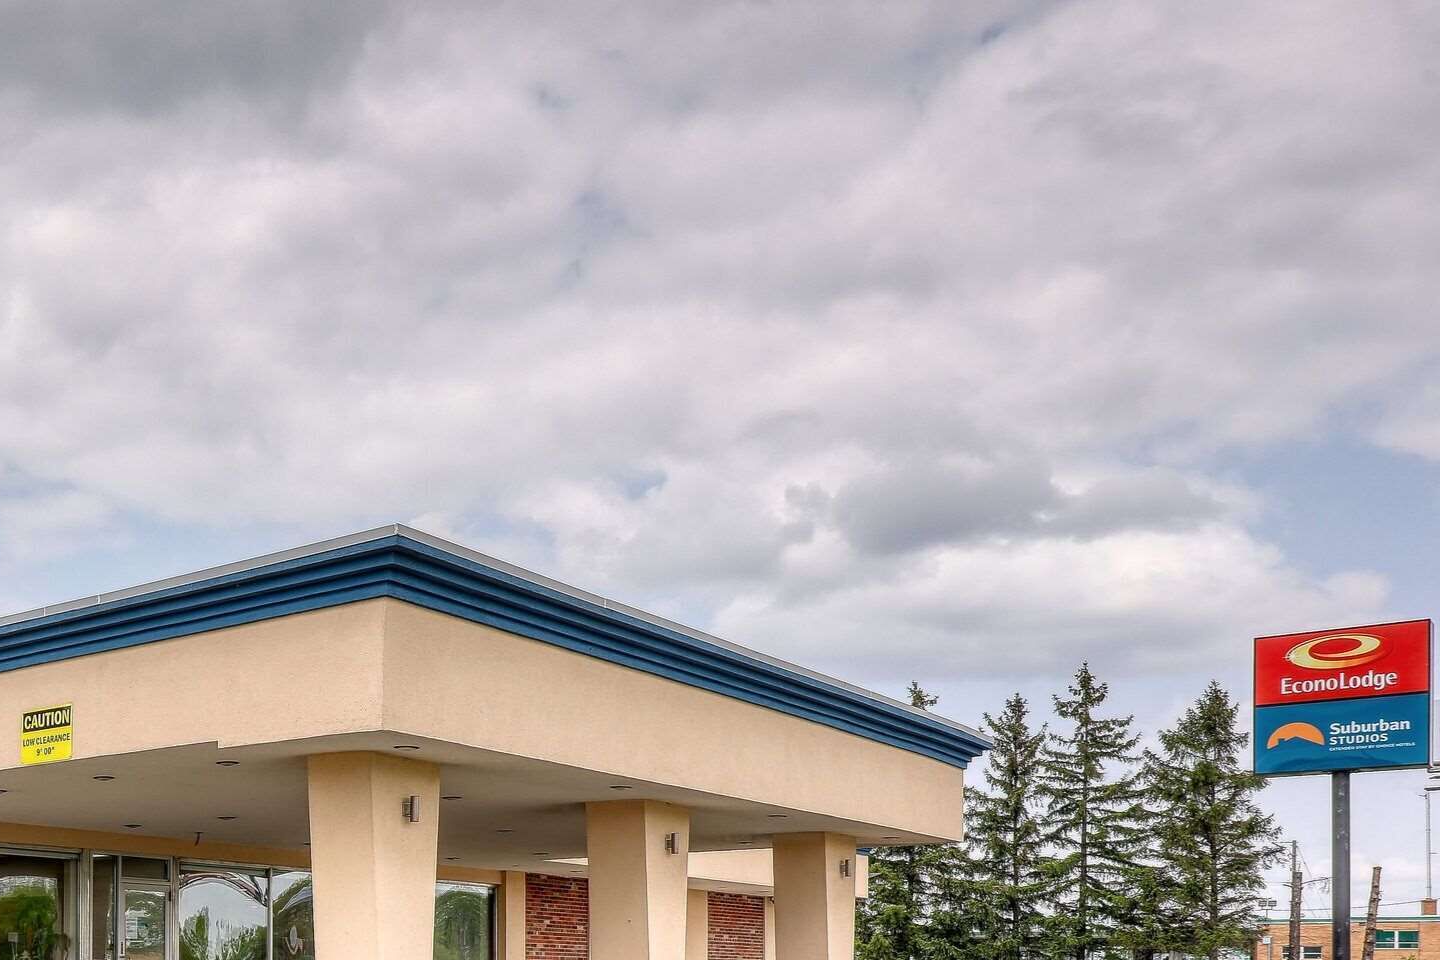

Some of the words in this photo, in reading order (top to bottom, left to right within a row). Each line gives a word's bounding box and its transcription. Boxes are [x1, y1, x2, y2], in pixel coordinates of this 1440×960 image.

[1280, 670, 1398, 695] EconoLodge
[24, 709, 70, 730] CAUTION
[1329, 718, 1411, 735] Suburban
[23, 738, 35, 747] LOW
[35, 733, 70, 745] CLEARANCE
[1329, 733, 1388, 745] STUDIOS
